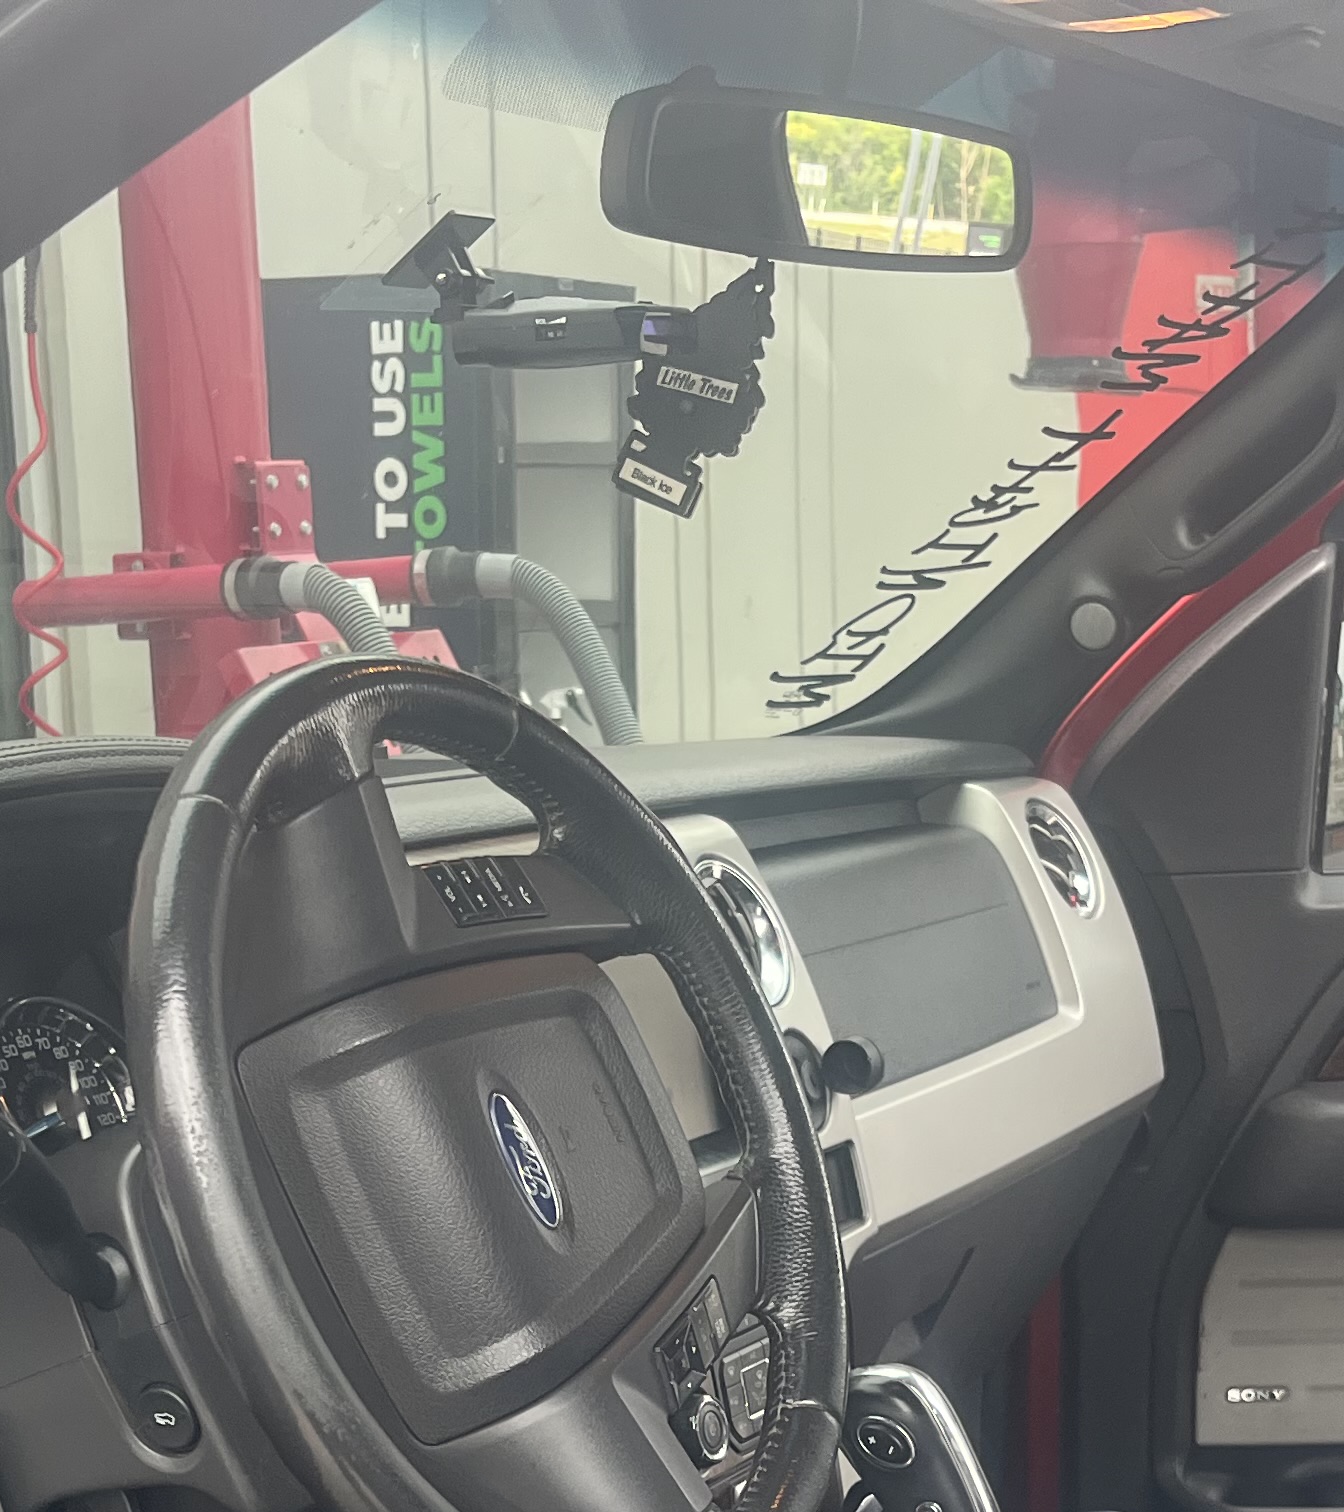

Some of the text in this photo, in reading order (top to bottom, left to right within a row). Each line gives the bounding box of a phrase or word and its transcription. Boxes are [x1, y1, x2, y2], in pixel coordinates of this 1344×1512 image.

[661, 368, 733, 401] Little Trees
[370, 319, 408, 539] TO USE
[409, 317, 447, 550] OWELS
[631, 467, 673, 495] Black Ice
[2, 1044, 19, 1058] 50
[16, 1034, 33, 1048] 60
[35, 1037, 51, 1051] 70
[52, 1045, 69, 1060] 80
[78, 1075, 98, 1089] 100
[96, 1112, 116, 1126] 120
[504, 1116, 552, 1199] Ford
[1227, 1387, 1286, 1403] SONY
